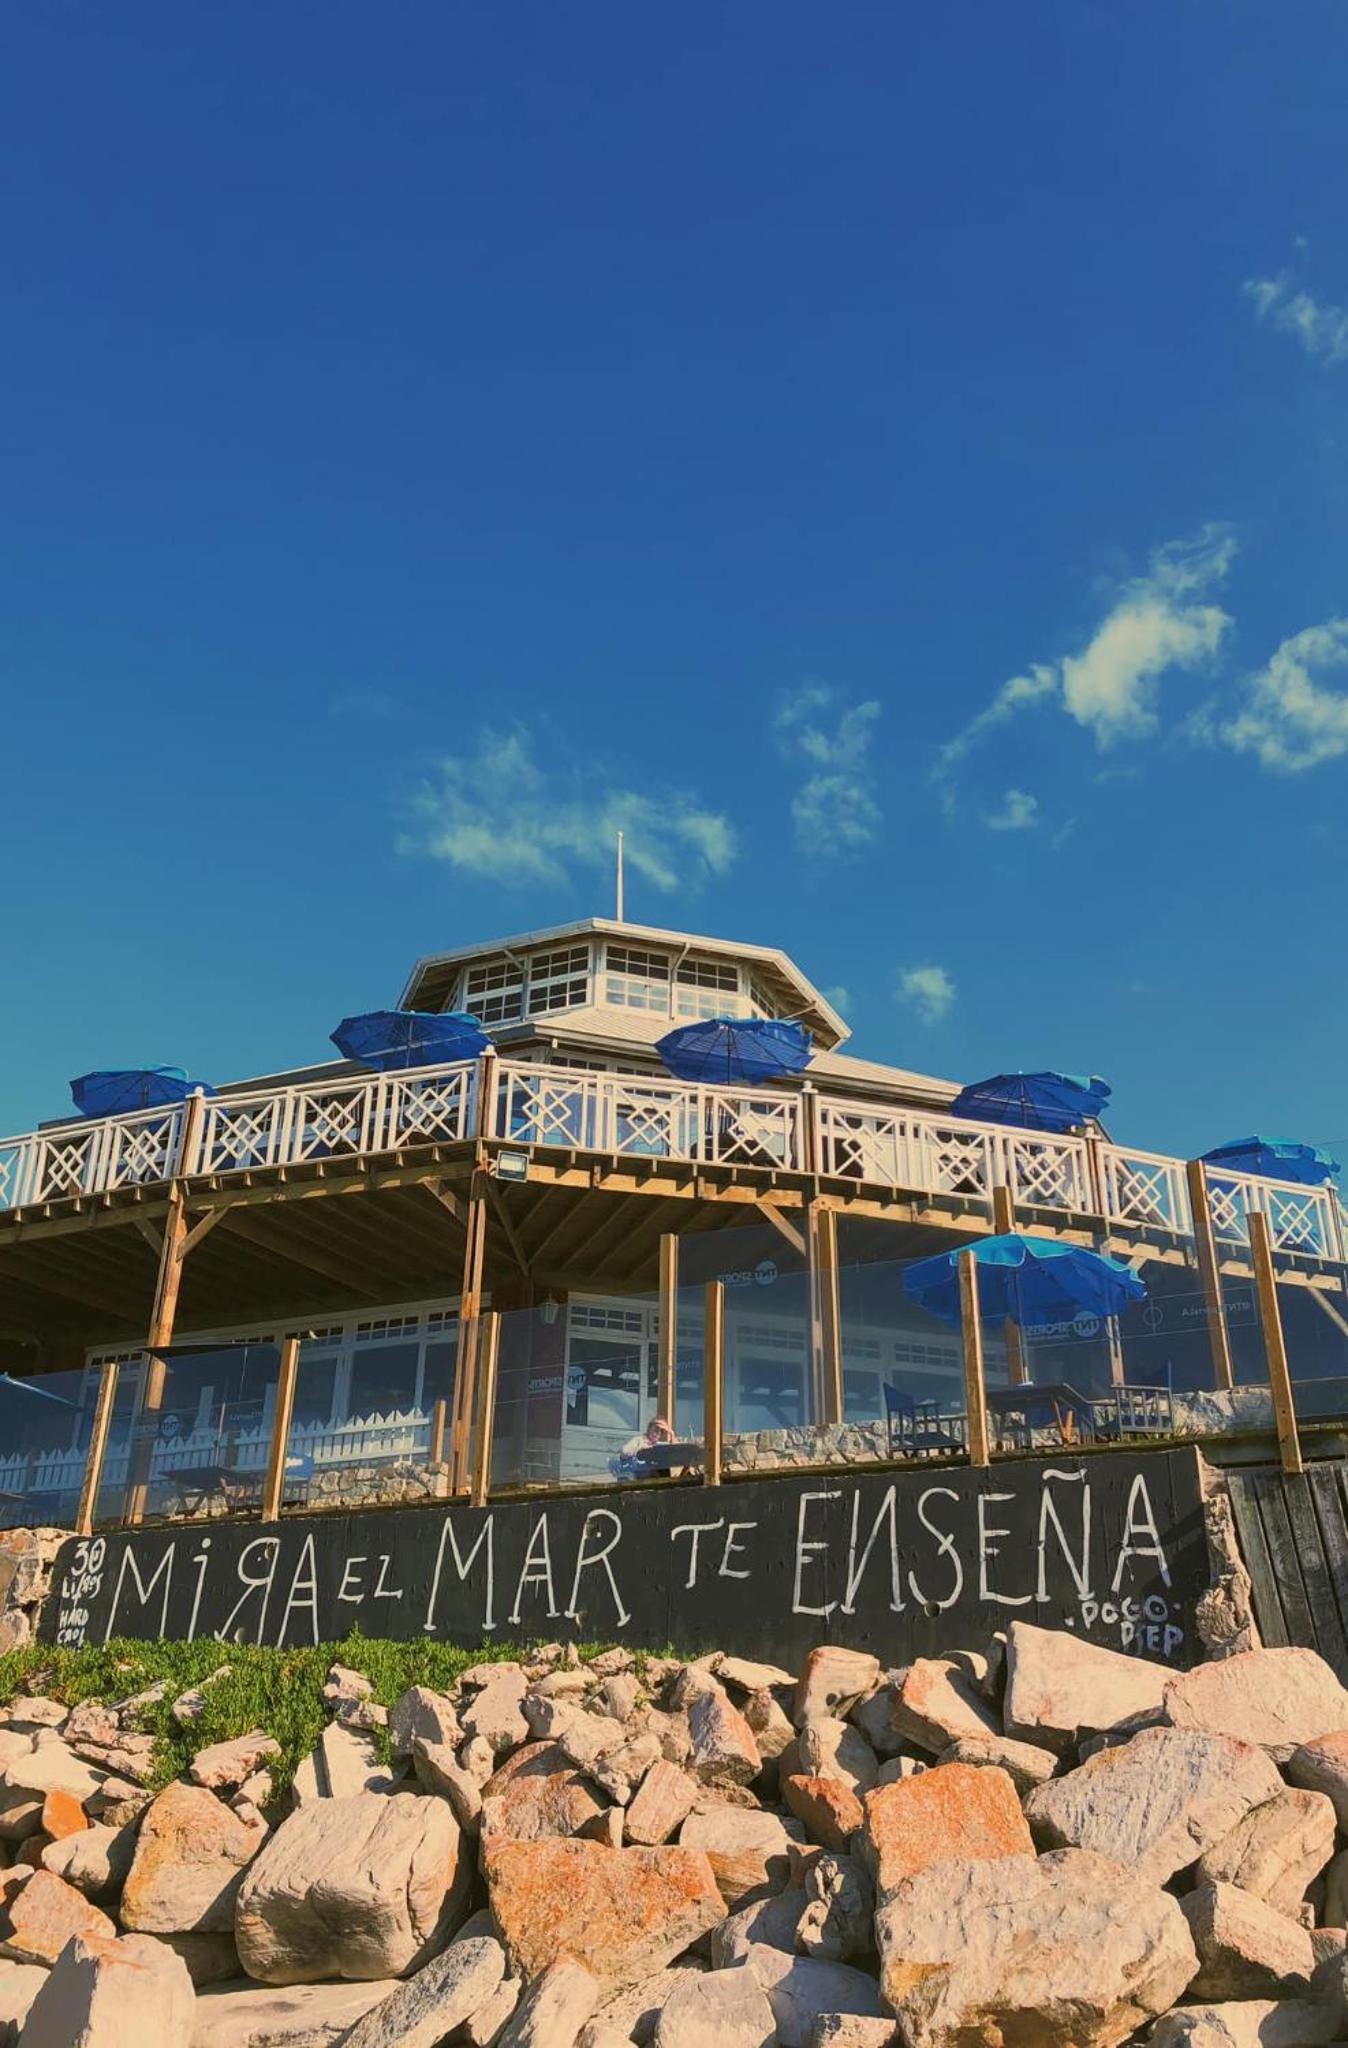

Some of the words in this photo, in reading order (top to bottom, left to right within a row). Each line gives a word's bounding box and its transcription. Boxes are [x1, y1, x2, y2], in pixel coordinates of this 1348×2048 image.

[338, 1554, 402, 1605] EL
[423, 1509, 632, 1631] MAR
[671, 1518, 758, 1589] TE
[793, 1468, 1172, 1615] ENSEÑA
